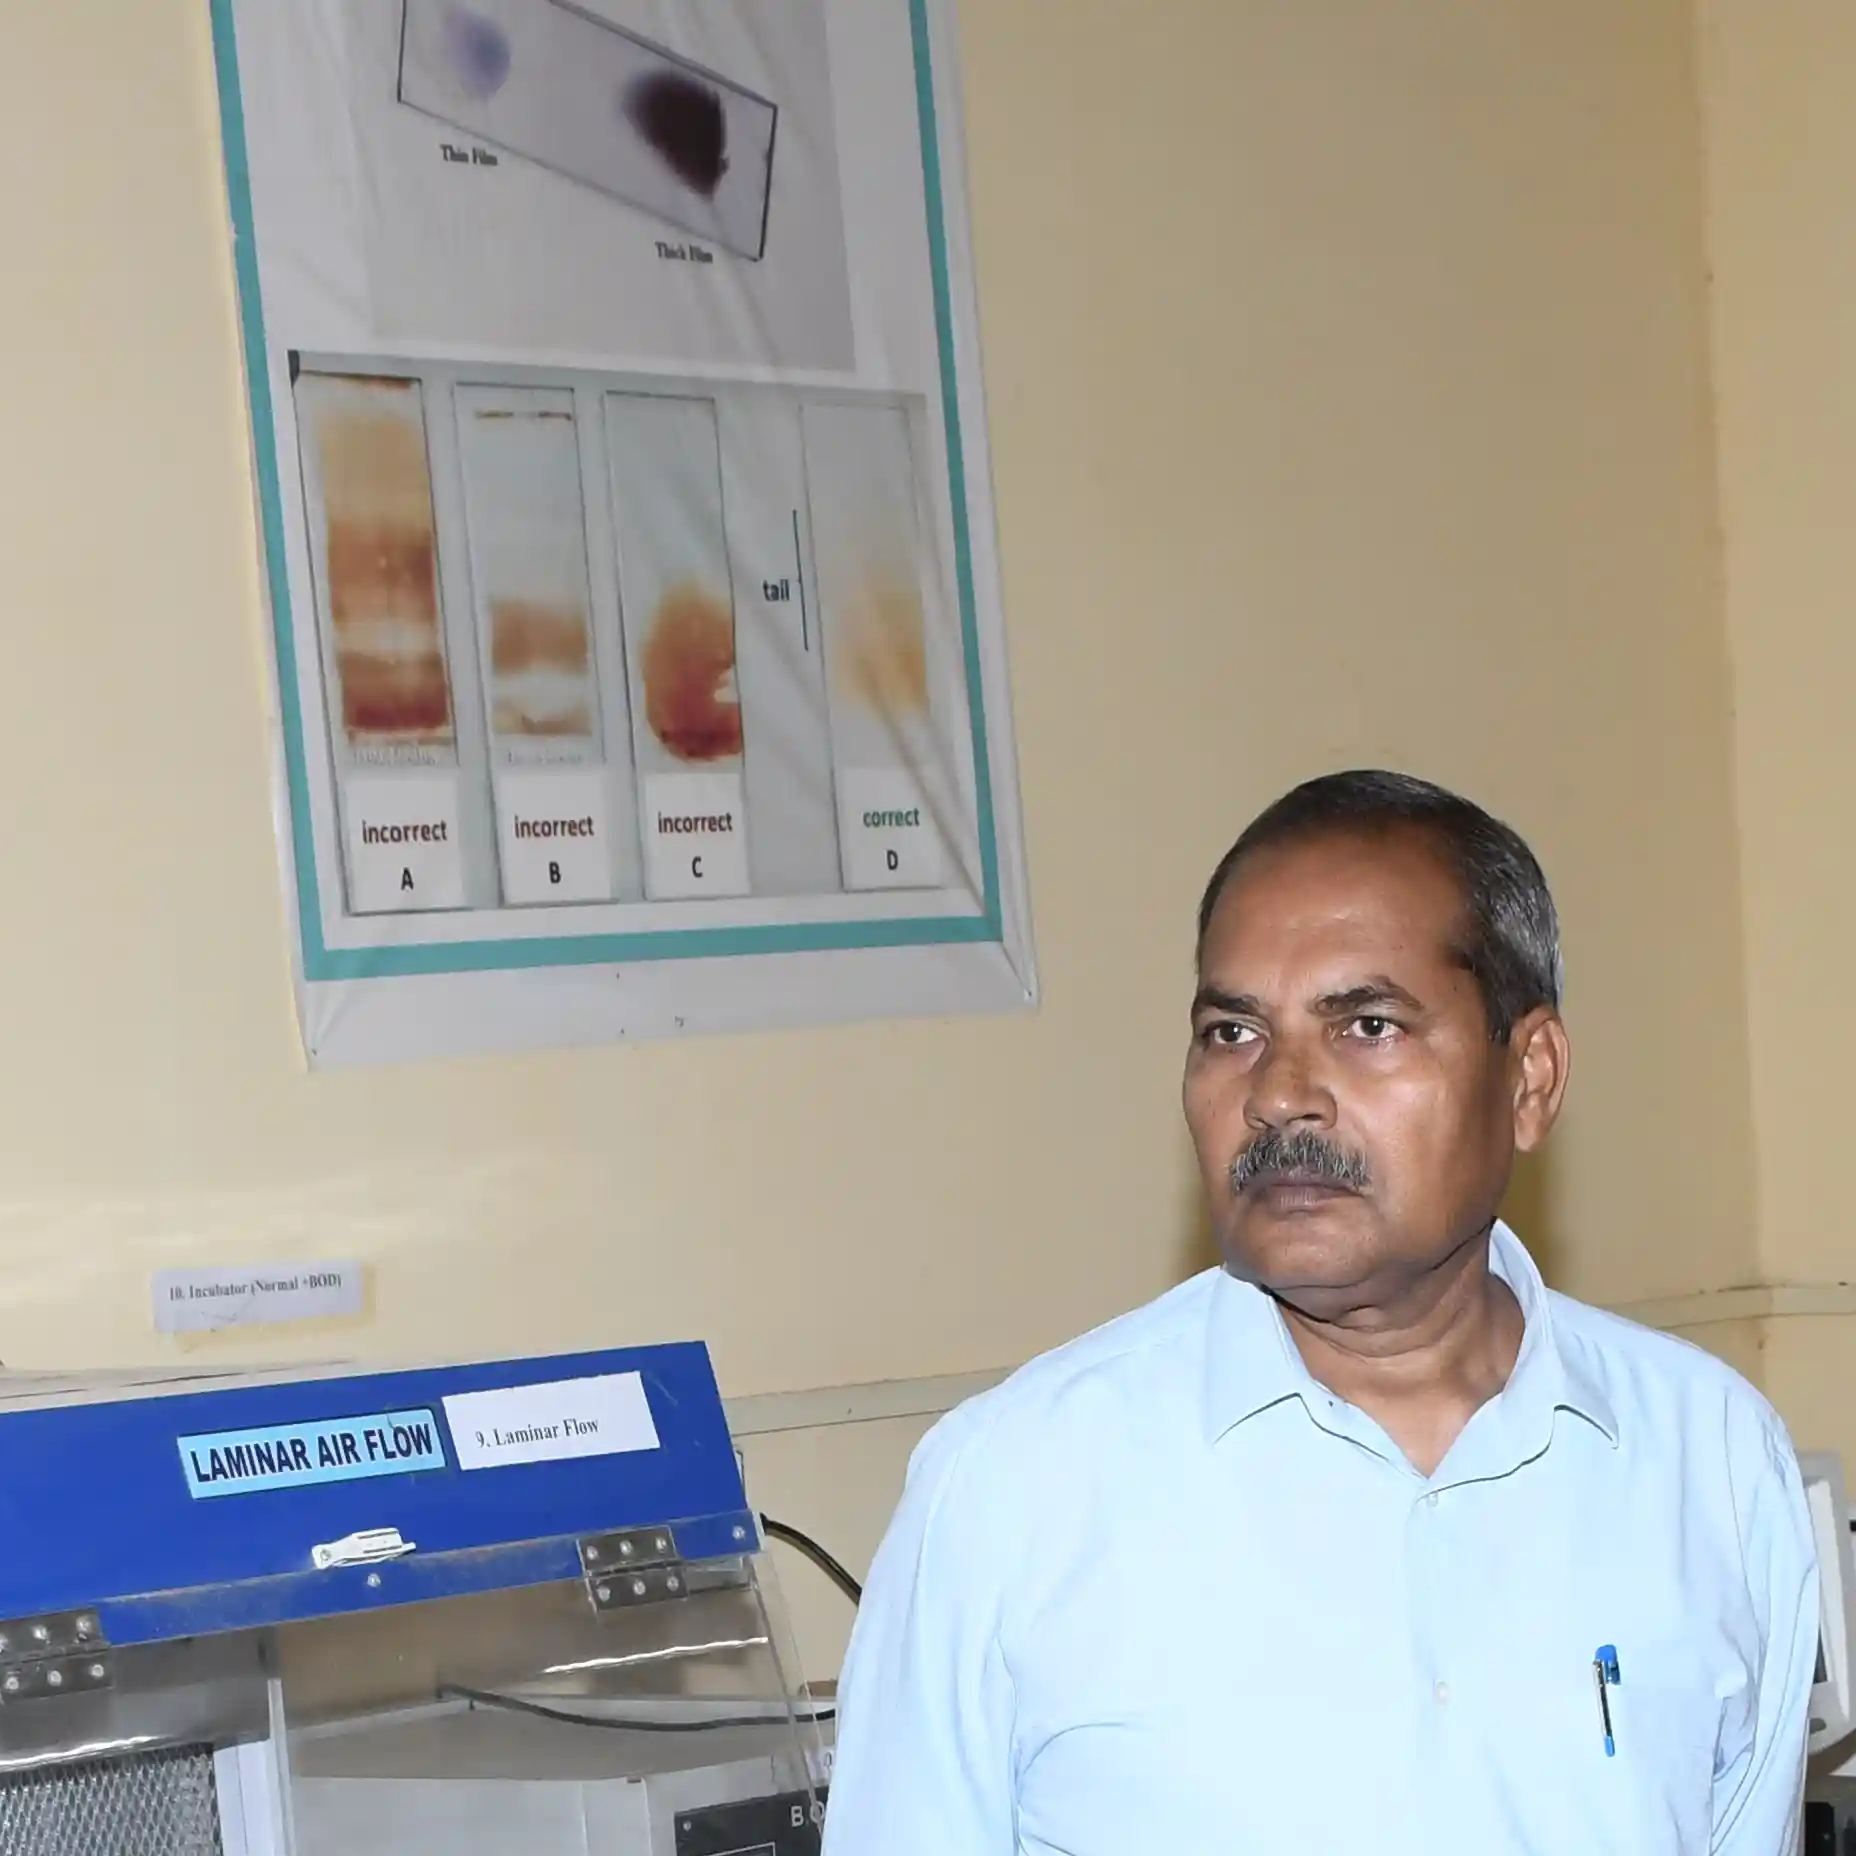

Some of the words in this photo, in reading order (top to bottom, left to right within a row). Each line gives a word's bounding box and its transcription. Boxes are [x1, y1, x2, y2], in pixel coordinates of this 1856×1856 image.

[762, 578, 791, 603] tail
[513, 812, 595, 842] incorrect
[656, 808, 734, 836] incorrect
[862, 805, 920, 831] correct
[361, 817, 449, 846] incorrect
[547, 860, 562, 886] B
[690, 855, 704, 880] C
[886, 849, 900, 872] D
[399, 866, 415, 893] A
[189, 1283, 248, 1299] Incubator
[251, 1276, 298, 1297] (Normal
[475, 1430, 491, 1448] 9.
[494, 1424, 559, 1447] Laminar
[562, 1416, 600, 1439] Flow
[190, 1439, 311, 1483] LAMINAR
[317, 1431, 362, 1469] AIR
[367, 1422, 434, 1463] FLOW
